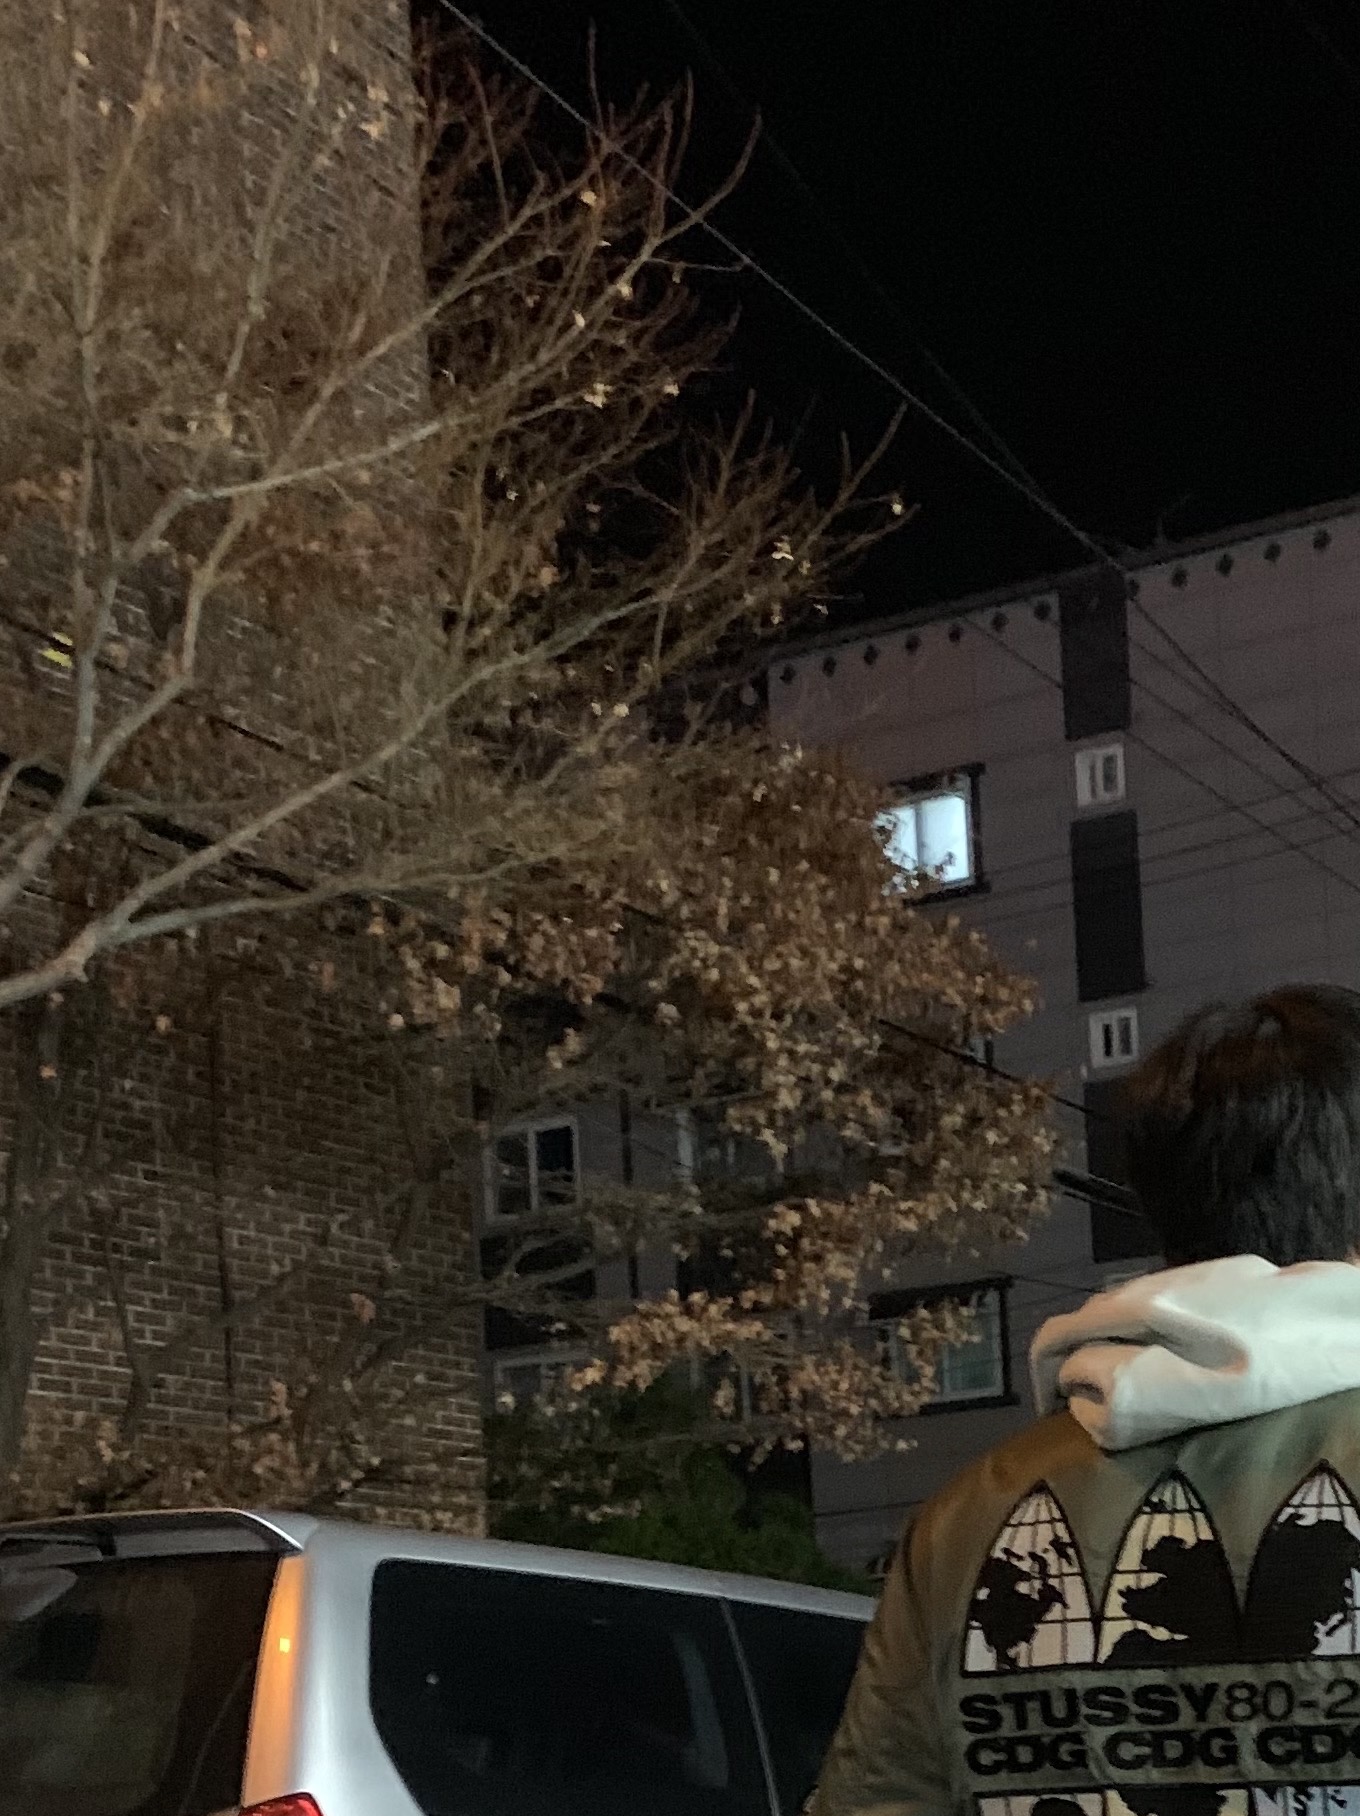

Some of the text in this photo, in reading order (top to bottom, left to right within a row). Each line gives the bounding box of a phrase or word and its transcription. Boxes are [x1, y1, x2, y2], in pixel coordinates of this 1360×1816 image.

[960, 1682, 1220, 1733] STUSSY
[965, 1732, 1090, 1776] CDG
[1105, 1727, 1238, 1770] CDG
